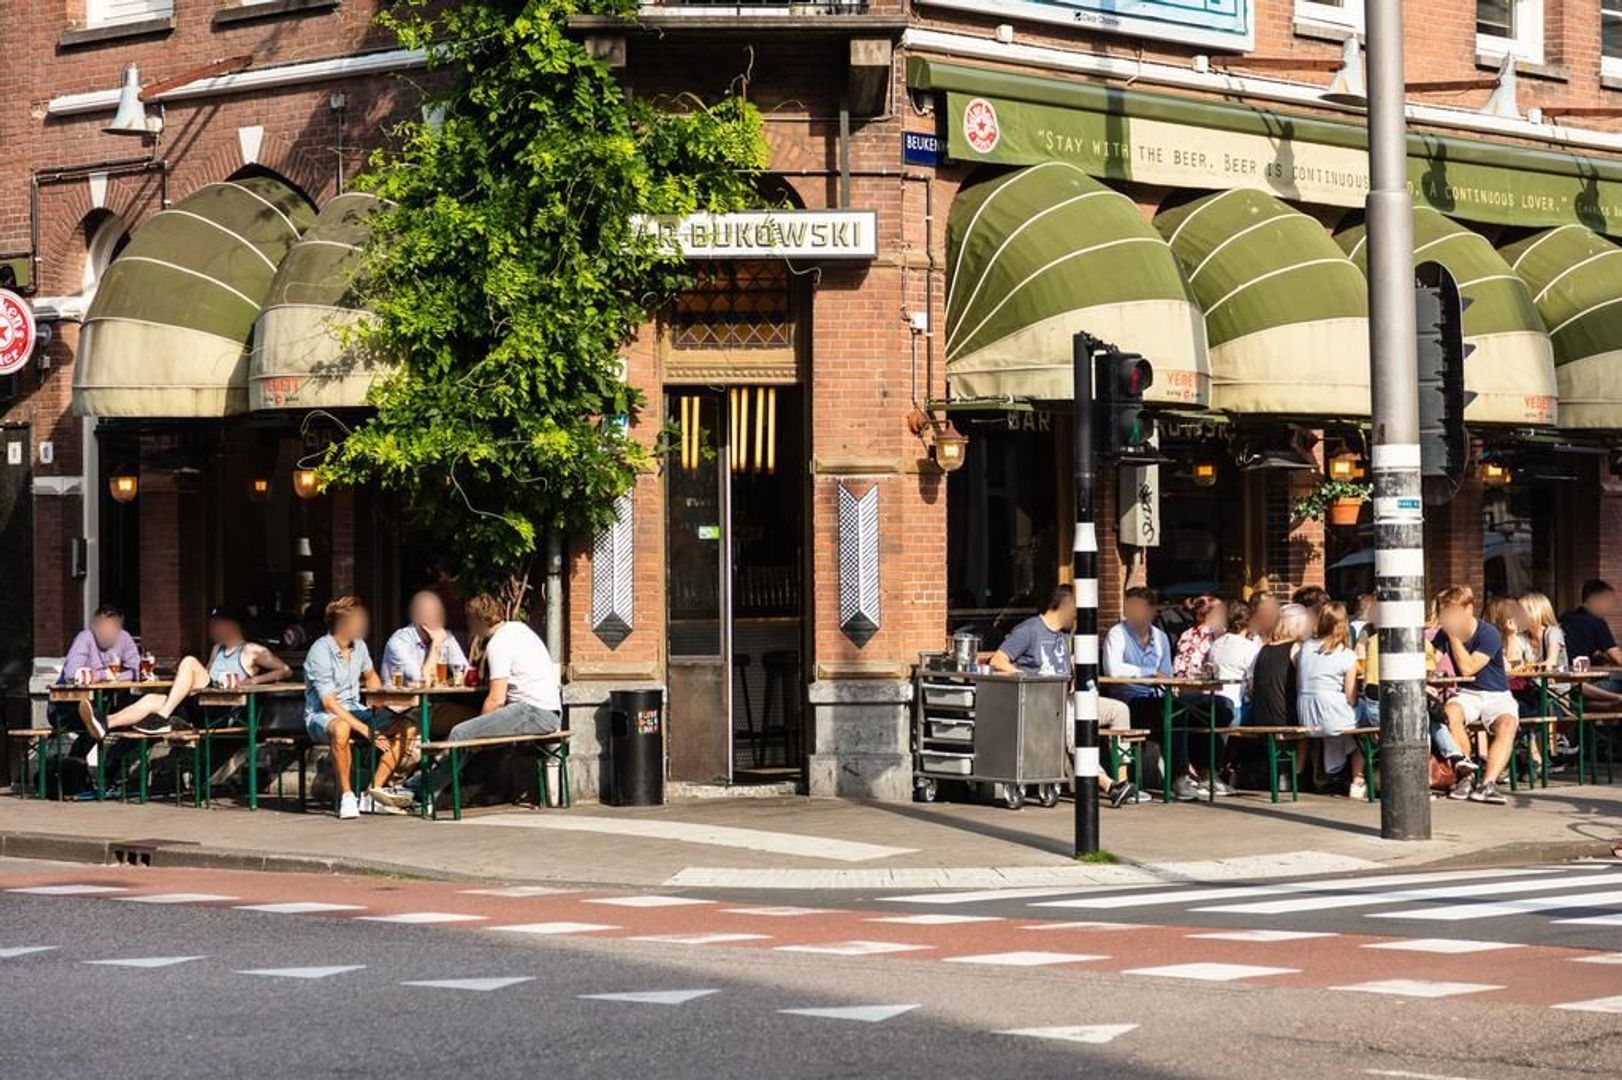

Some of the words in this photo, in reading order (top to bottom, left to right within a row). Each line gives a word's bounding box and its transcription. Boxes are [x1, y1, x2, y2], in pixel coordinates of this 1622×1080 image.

[1093, 140, 1129, 158] WITH
[1139, 145, 1164, 163] THE
[1174, 150, 1214, 168] BEER.
[1224, 154, 1256, 174] BEER
[1267, 163, 1282, 178] IS
[1293, 167, 1369, 189] CONTINUOUS
[1447, 188, 1514, 207] CONTINUOUS
[632, 222, 680, 248] AR
[691, 221, 861, 248] BUKOWSKI
